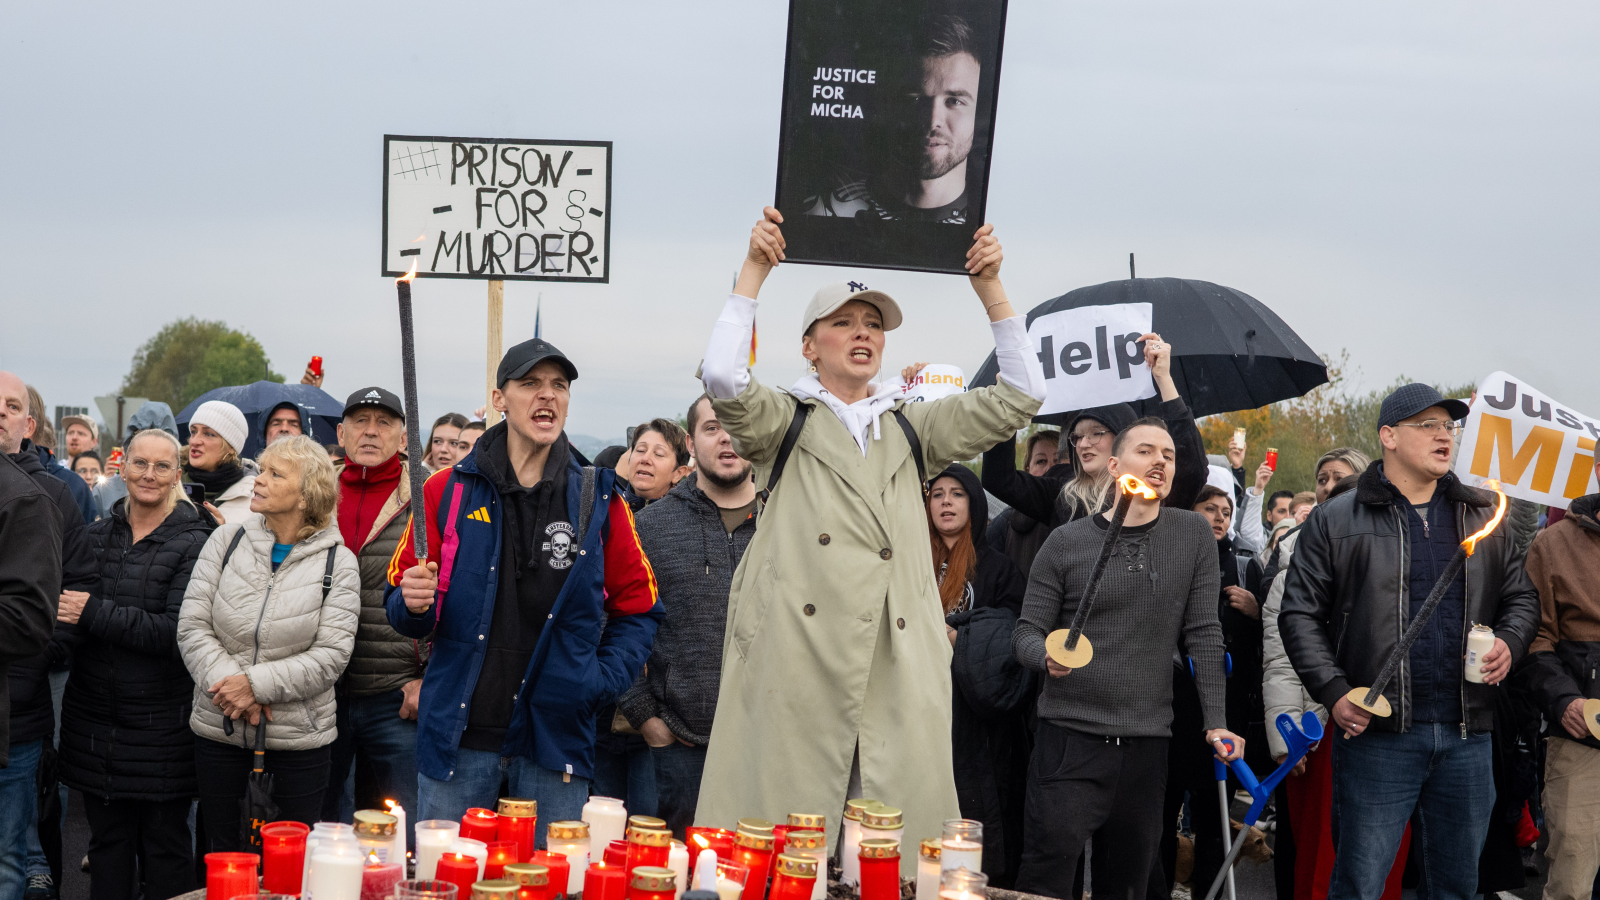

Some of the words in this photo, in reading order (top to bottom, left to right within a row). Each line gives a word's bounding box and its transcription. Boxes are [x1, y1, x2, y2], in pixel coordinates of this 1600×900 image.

[813, 67, 876, 84] JUSTICE
[812, 84, 844, 100] FOR
[810, 102, 864, 119] MICHA
[451, 142, 573, 188] PRISON
[476, 187, 548, 230] FOR
[431, 229, 594, 276] MURDER
